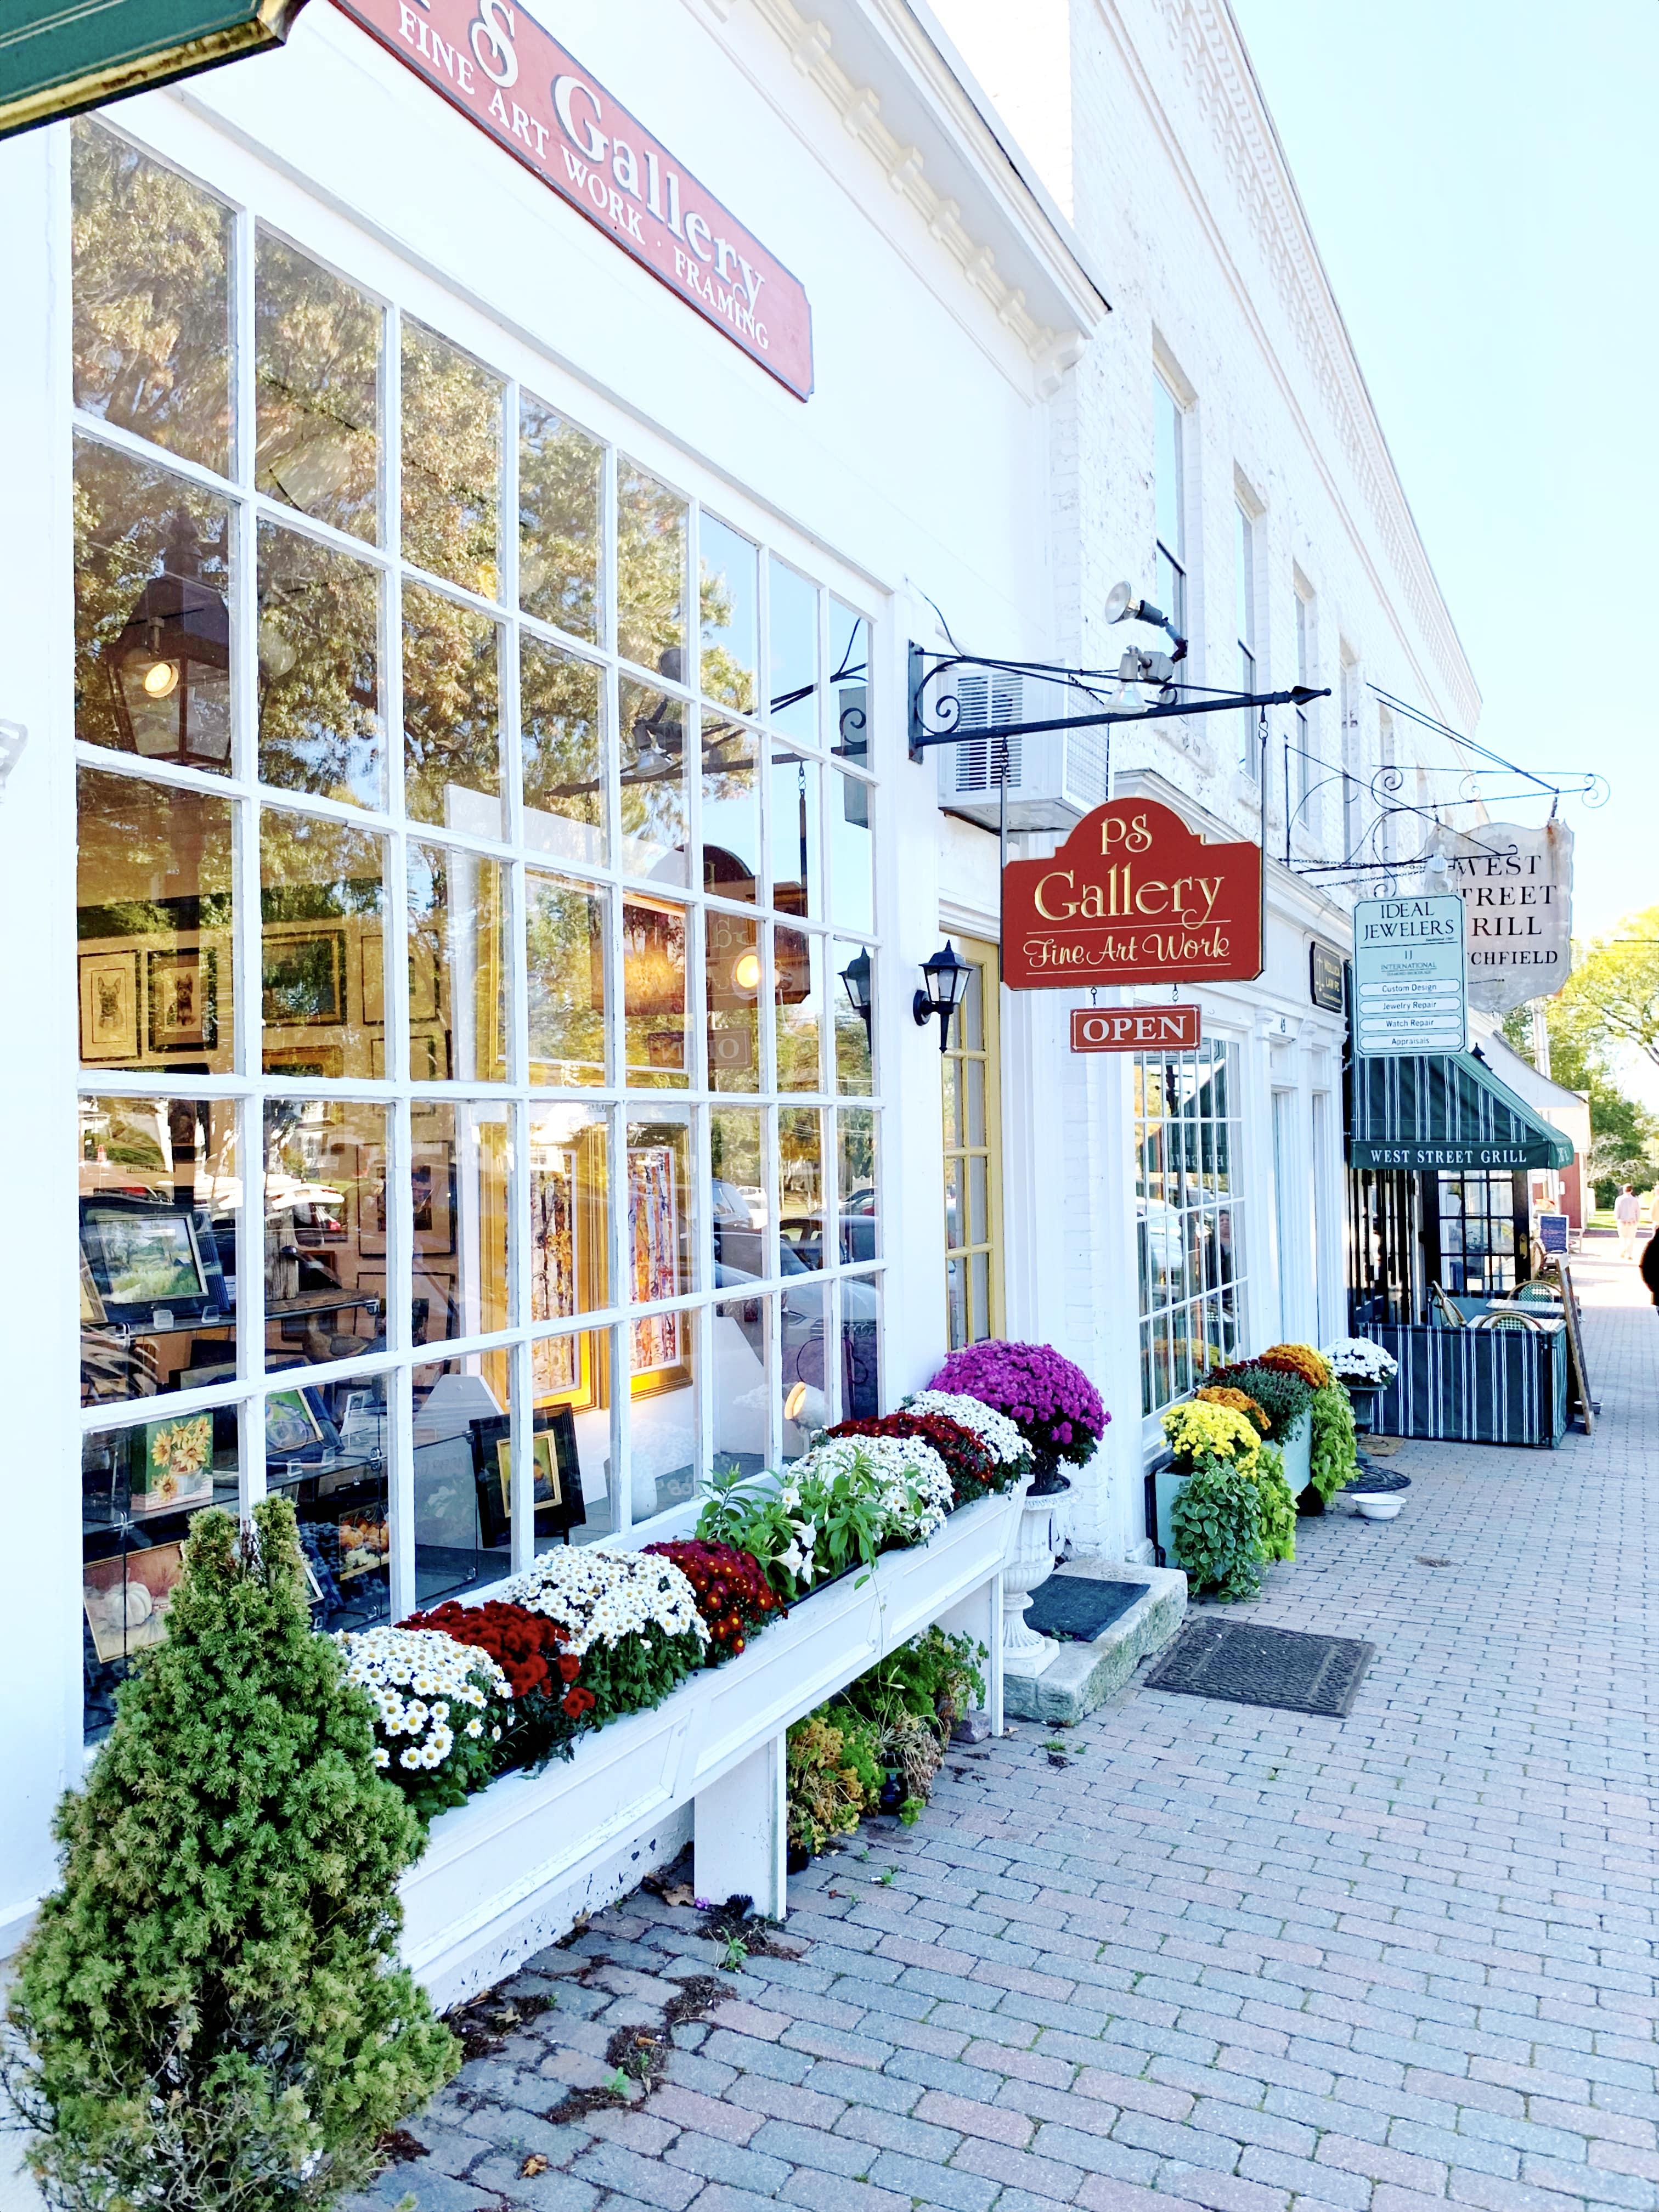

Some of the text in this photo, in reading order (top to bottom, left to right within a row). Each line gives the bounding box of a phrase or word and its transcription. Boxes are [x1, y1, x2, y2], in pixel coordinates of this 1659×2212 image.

[398, 0, 769, 350] FINE ART WORK FRAMING
[552, 74, 765, 316] Gallery
[1457, 855, 1541, 876] WEST
[1034, 862, 1225, 930] Gallery
[1459, 885, 1557, 906] TREET
[1381, 901, 1435, 919] IDEAL
[1363, 919, 1454, 941] JEWELERS
[1470, 916, 1542, 936] RILL
[1023, 927, 1230, 968] Fine Art Work
[1468, 950, 1559, 965] CHFIELD
[1381, 961, 1437, 970] INTERNATIONAL
[1412, 984, 1437, 994] Design
[1383, 1001, 1437, 1011] Jewelry Repair
[1082, 1015, 1187, 1041] OPEN
[1410, 1019, 1434, 1028] Repair
[1391, 1037, 1430, 1046] Appraisals
[1370, 1149, 1527, 1164] WEST STREET GRILL
